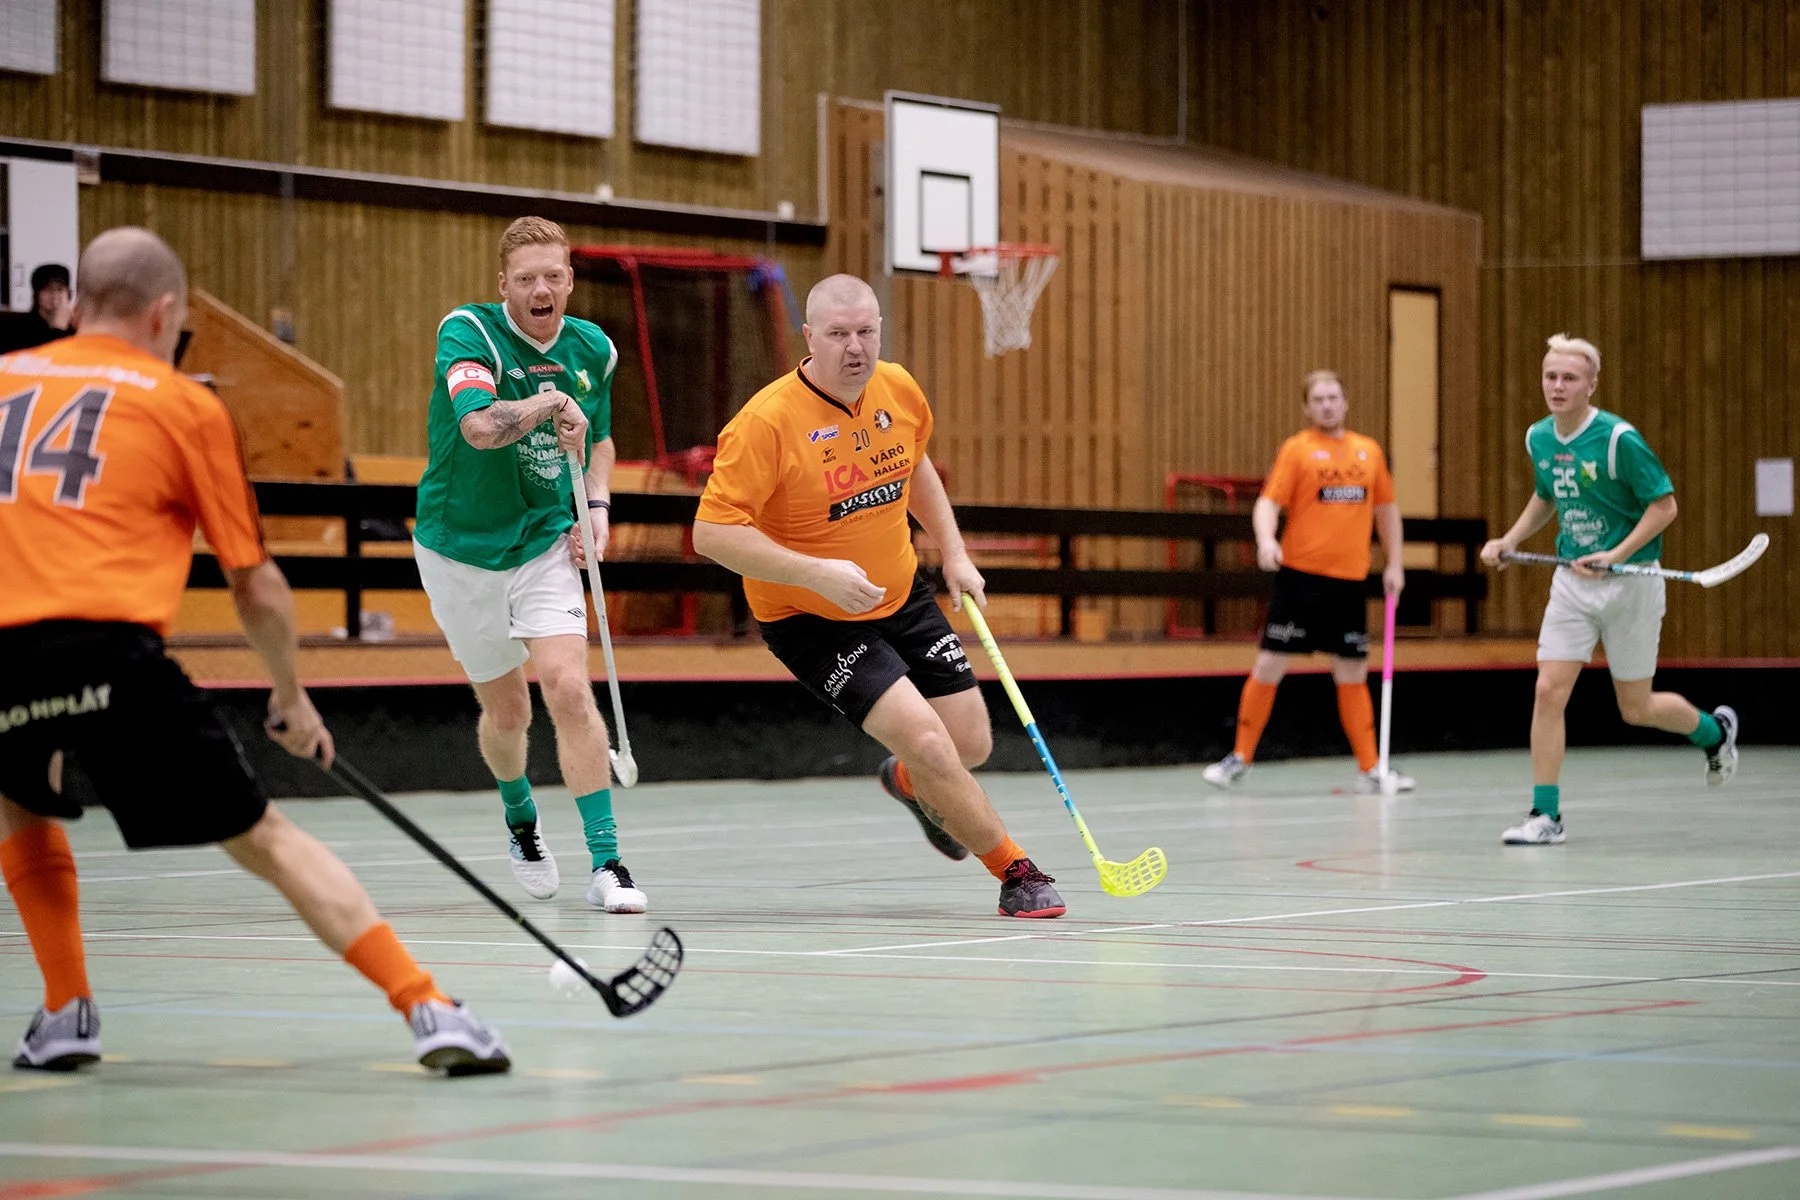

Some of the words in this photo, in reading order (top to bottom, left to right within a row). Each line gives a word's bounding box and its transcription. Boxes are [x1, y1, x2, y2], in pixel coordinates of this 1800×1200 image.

[463, 368, 480, 379] C
[528, 365, 547, 373] TEAM
[0, 383, 117, 510] 14
[851, 428, 870, 452] 20
[870, 442, 905, 466] VÄRÖ
[824, 463, 870, 495] ICA
[874, 458, 910, 478] HALLEN
[1552, 467, 1580, 498] 25
[840, 481, 901, 510] VISION
